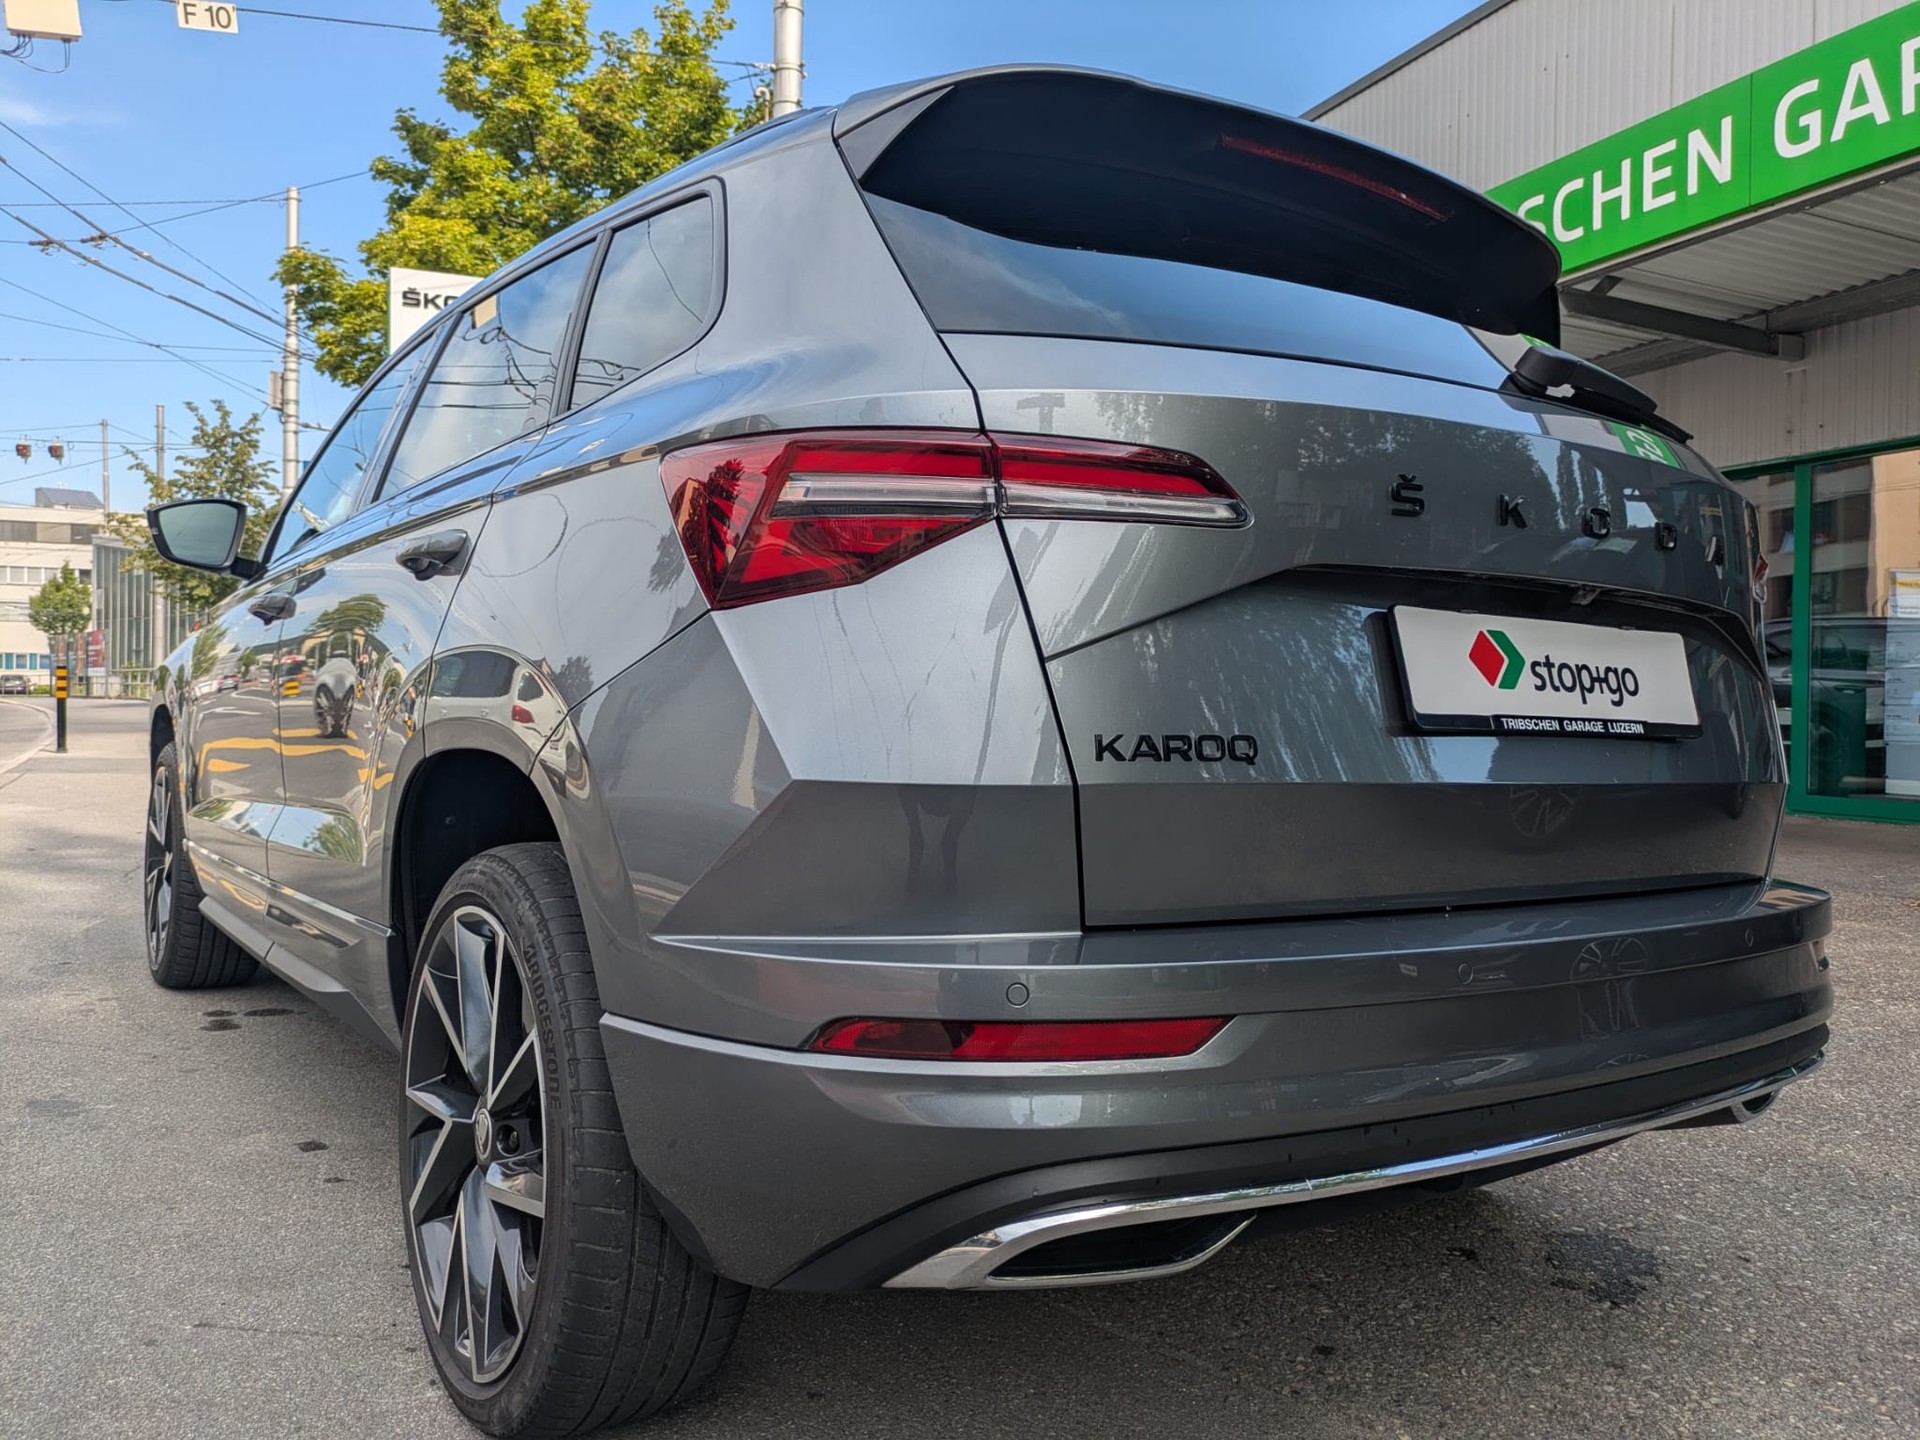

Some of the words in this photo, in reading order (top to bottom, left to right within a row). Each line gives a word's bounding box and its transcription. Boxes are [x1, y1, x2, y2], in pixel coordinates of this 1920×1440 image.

[183, 2, 197, 25] F
[204, 5, 232, 29] 10
[1500, 717, 1560, 732] TRIBSCHEN
[1563, 720, 1605, 733] GARAGE
[1607, 722, 1645, 735] LUZERN
[1094, 734, 1259, 766] KAROQ
[523, 942, 562, 1110] BRIDGESTONE
